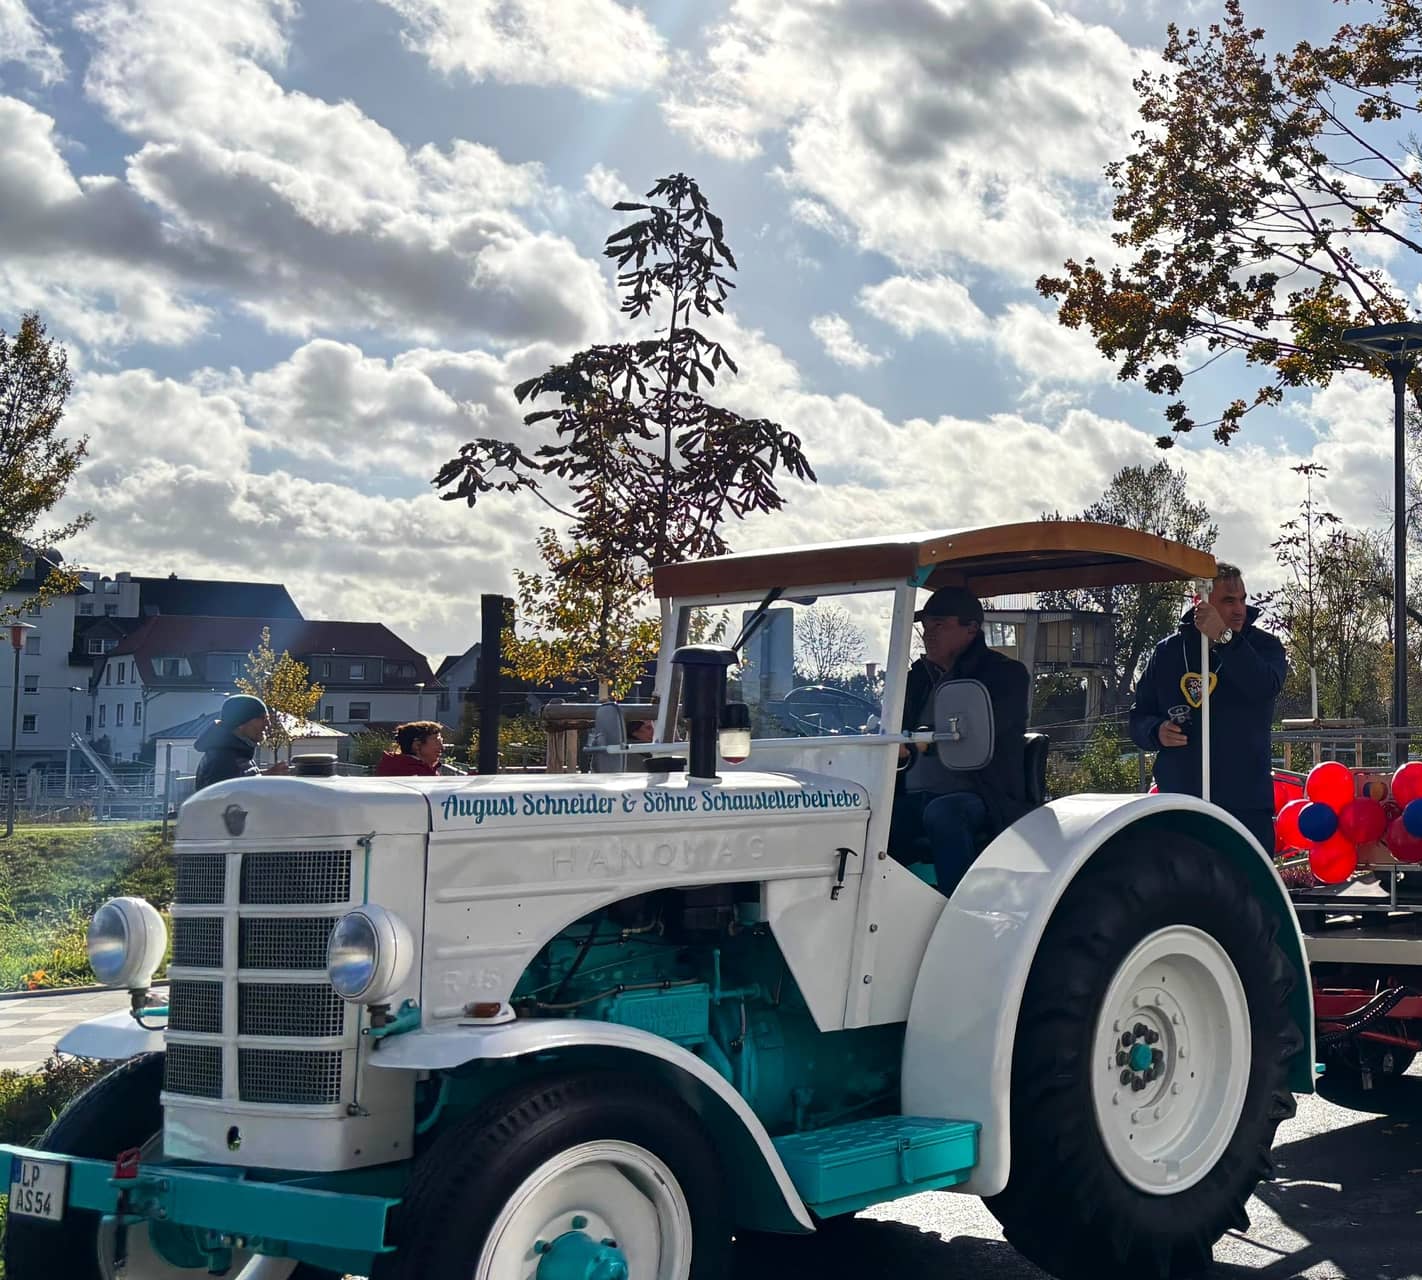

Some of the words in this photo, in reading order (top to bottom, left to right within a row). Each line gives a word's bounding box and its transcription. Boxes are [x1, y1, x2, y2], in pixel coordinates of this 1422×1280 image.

[440, 793, 517, 824] August
[523, 793, 616, 816] Schneider
[621, 793, 637, 813] &
[643, 789, 696, 814] Söhne
[702, 788, 862, 812] Schaustellerbetriebe
[551, 835, 766, 874] HANOMAG
[22, 1163, 40, 1188] LP
